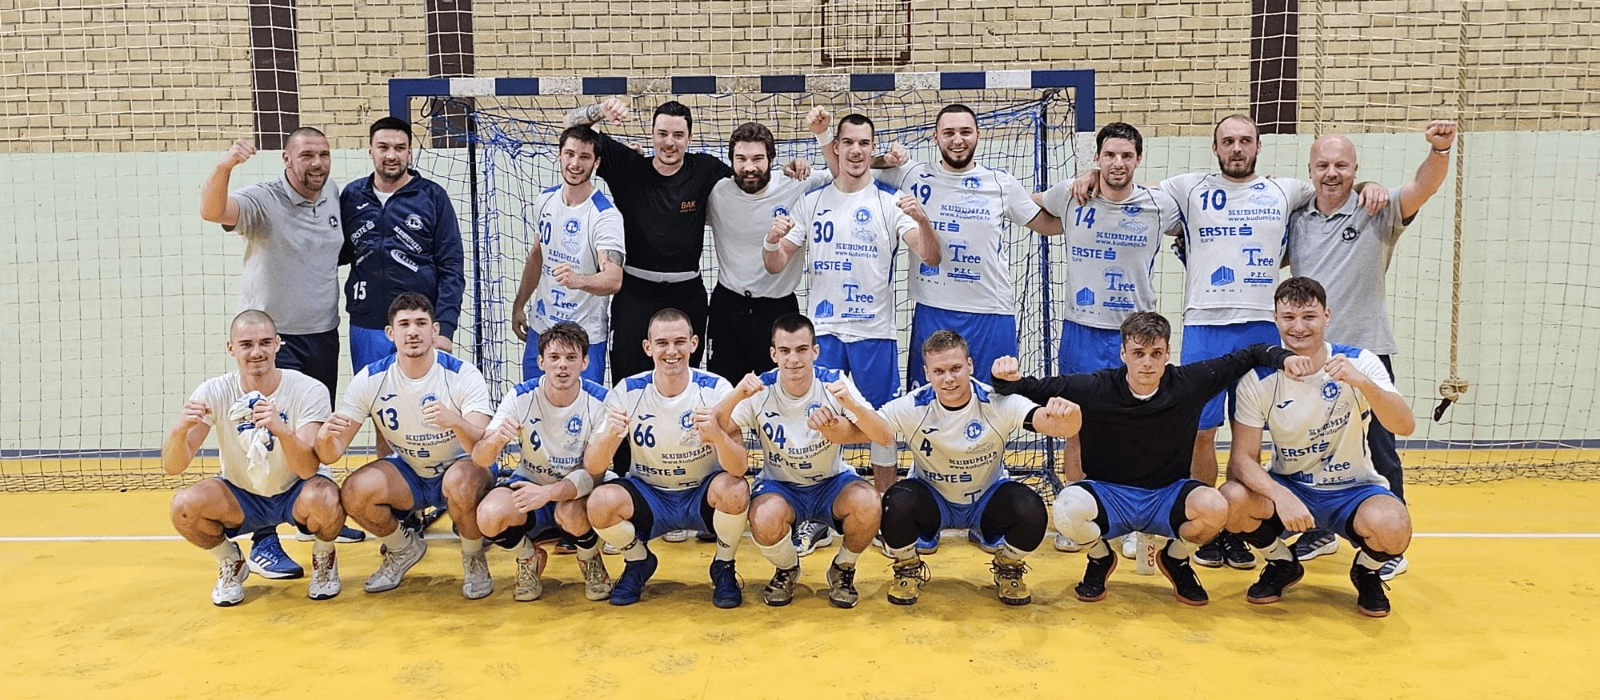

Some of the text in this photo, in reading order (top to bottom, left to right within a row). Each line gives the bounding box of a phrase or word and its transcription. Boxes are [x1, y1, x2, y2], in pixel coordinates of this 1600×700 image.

[910, 182, 932, 206] 19
[1199, 188, 1227, 211] 10
[1075, 206, 1096, 229] 14
[813, 220, 834, 243] 30
[1096, 231, 1148, 243] KUDUMIJA
[1199, 226, 1237, 237] ERSTE
[948, 244, 981, 264] Tree
[1072, 246, 1102, 259] ERSTE
[1242, 248, 1274, 266] Tree
[353, 281, 367, 300] 15
[1105, 272, 1136, 292] Tree
[551, 289, 578, 309] Tree
[843, 283, 874, 303] Tree
[376, 407, 399, 431] 13
[530, 430, 541, 452] 9
[633, 423, 656, 448] 66
[920, 437, 933, 457] 4
[1281, 443, 1319, 457] ERSTE
[635, 463, 672, 477] ERSTE
[1147, 544, 1156, 567] GAZ
